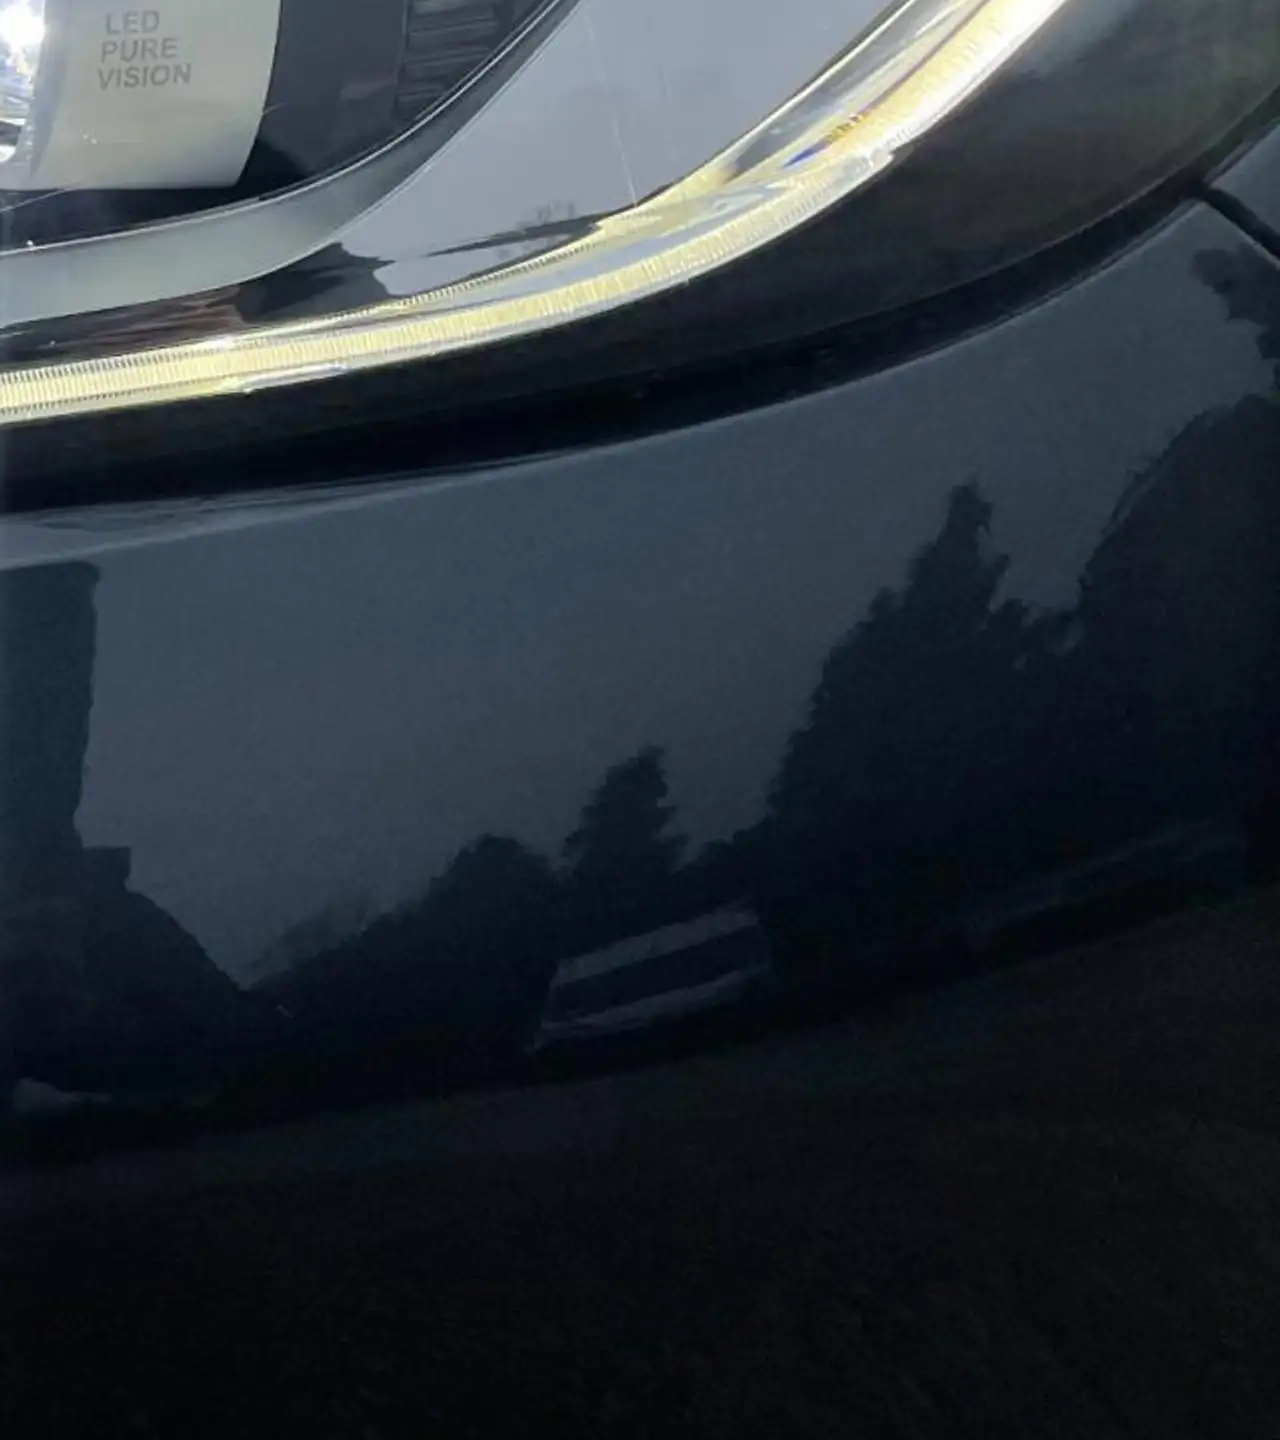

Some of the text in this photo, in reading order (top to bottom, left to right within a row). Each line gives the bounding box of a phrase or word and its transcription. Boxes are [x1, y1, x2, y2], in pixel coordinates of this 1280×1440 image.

[105, 10, 160, 35] LED
[100, 37, 178, 63] PURE
[97, 63, 192, 90] VISION
